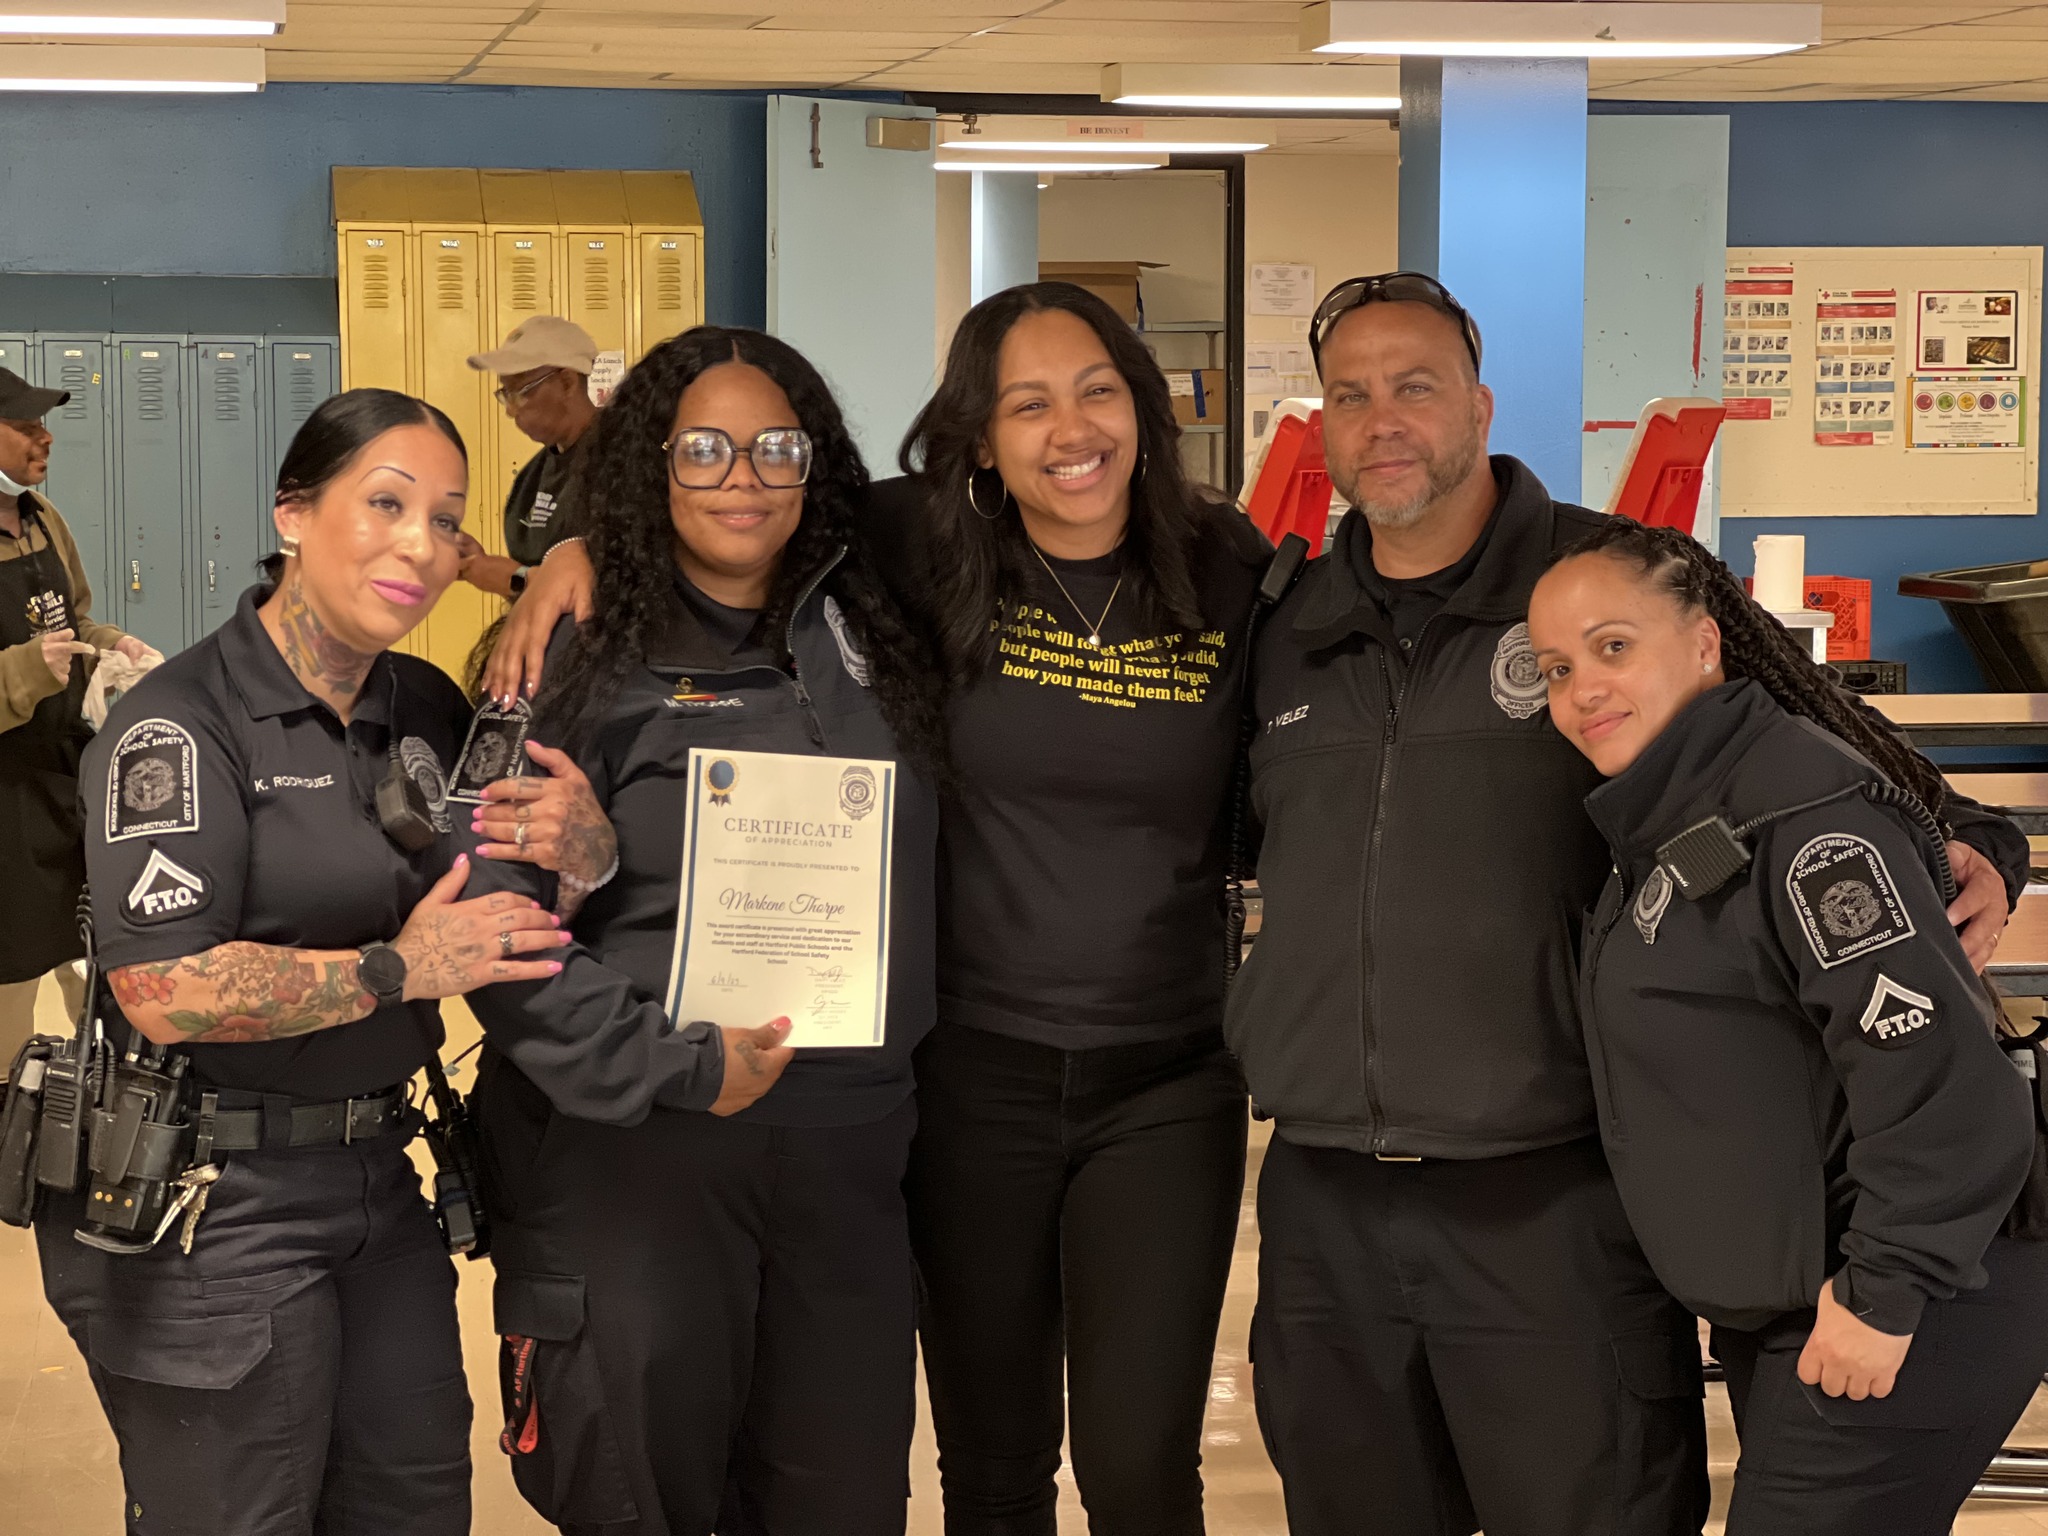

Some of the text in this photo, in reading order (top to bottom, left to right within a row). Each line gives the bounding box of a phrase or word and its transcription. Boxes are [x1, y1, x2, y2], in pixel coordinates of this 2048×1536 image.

[1044, 630, 1073, 648] will
[1000, 638, 1211, 686] but people will never forget
[1002, 660, 1039, 680] how
[1039, 671, 1073, 686] you
[1076, 676, 1124, 694] made
[1128, 682, 1171, 700] them
[1103, 696, 1137, 708] Angelou
[1506, 700, 1535, 708] OFFICER
[1275, 704, 1309, 727] VELEZ
[120, 737, 184, 756] SCHOOL SAFETY
[143, 733, 154, 741] OF
[181, 745, 191, 788] HARTFORD
[254, 779, 269, 792] K.
[183, 803, 192, 821] CITY
[123, 820, 178, 834] CONNECTICUT
[724, 817, 853, 839] CERTIFICATE
[745, 836, 832, 848] OF APPRECIATION
[729, 858, 768, 868] CERTIFICATE
[777, 861, 808, 869] PROUDLY
[809, 863, 849, 872] PRESENTED
[1795, 845, 1864, 880] SCHOOL SAFETY
[1796, 839, 1855, 869] DEPARTMENT
[1820, 849, 1832, 859] OF
[142, 886, 198, 916] F.T.O.
[1864, 852, 1904, 928] CITY OF HARTFORD
[719, 888, 845, 920] Markene Thorpe
[1791, 880, 1830, 958] BOARD OF EDUCATION
[1837, 929, 1892, 957] CONNECTICUT
[1874, 1008, 1931, 1040] F.T.O.
